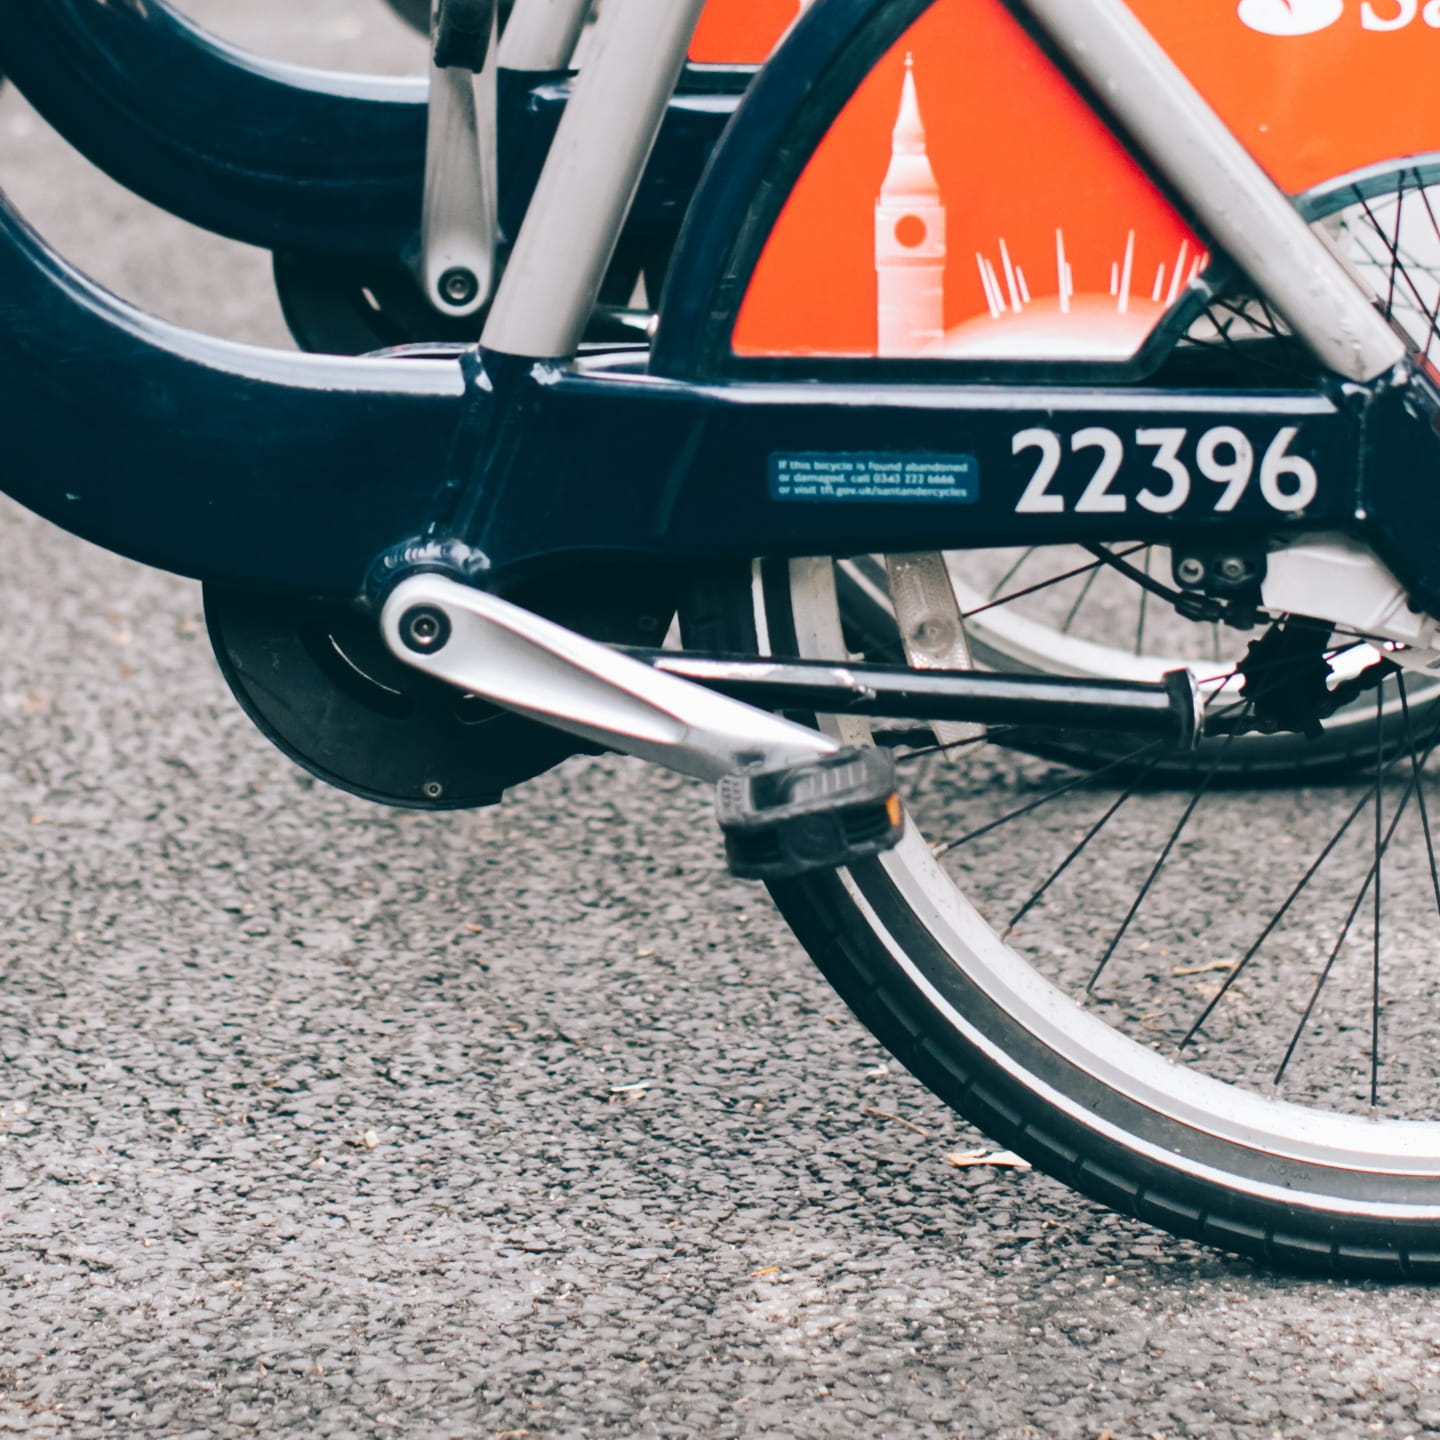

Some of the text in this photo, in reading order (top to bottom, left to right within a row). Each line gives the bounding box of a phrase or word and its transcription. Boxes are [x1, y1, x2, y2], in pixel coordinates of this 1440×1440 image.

[789, 460, 811, 470] this
[813, 461, 853, 472] bicycle
[856, 462, 866, 471] is
[868, 461, 903, 472] found
[905, 462, 968, 472] abandoned
[1011, 425, 1317, 513] 22396
[778, 474, 790, 482] or
[850, 474, 870, 483] call
[778, 486, 790, 494] or
[794, 486, 817, 495] visit
